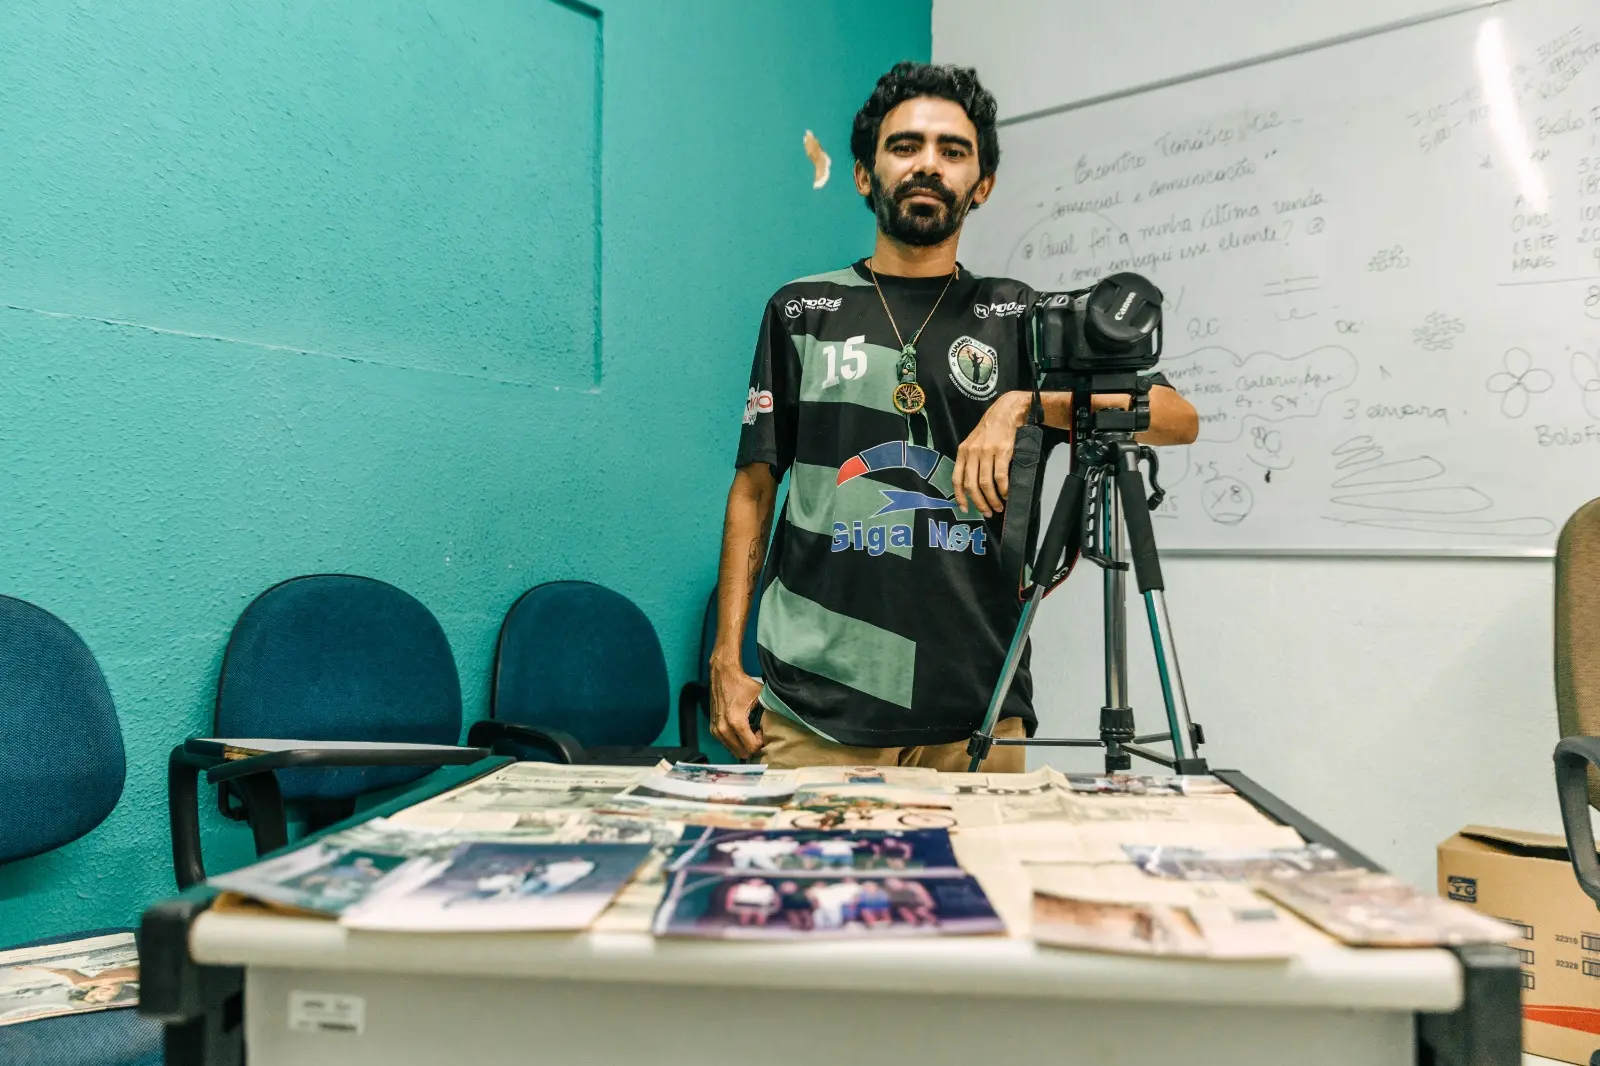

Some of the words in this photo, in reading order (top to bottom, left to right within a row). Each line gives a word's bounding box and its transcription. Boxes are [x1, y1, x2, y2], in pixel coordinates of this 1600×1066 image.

[1118, 231, 1129, 245] a
[1138, 213, 1192, 242] minha
[1272, 186, 1330, 214] venda
[801, 297, 843, 308] MOOZE
[1114, 291, 1137, 321] Canon
[822, 335, 868, 390] 15
[831, 520, 913, 557] Giga
[928, 517, 987, 556] Net
